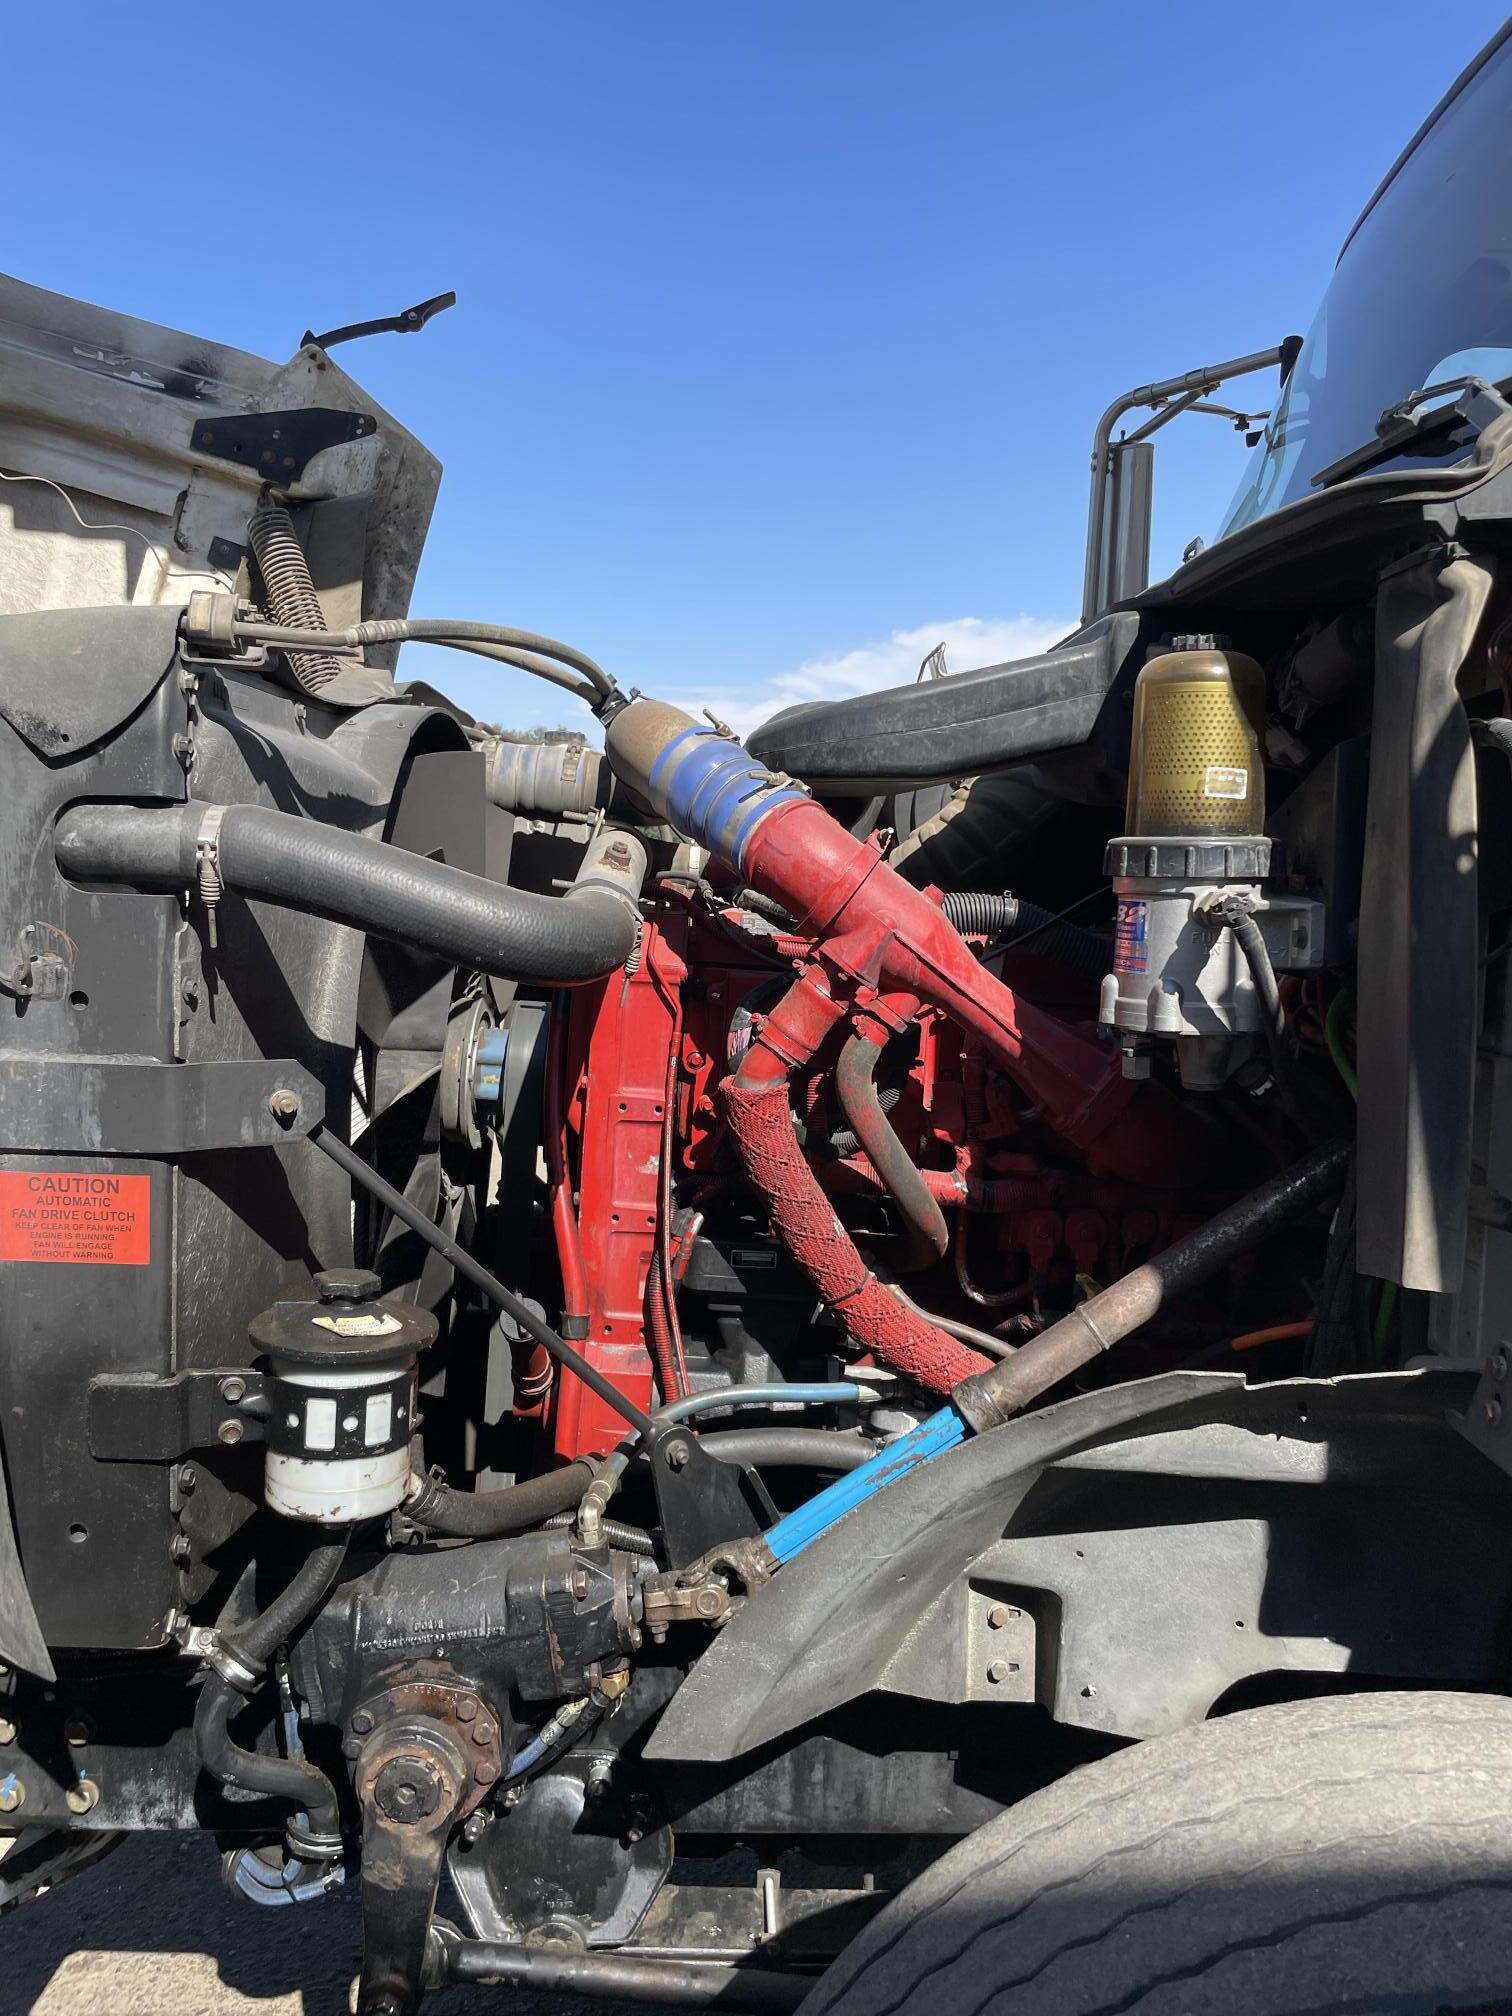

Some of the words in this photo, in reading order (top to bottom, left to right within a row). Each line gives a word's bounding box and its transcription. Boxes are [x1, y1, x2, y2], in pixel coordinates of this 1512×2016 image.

[28, 1176, 120, 1194] CAUTION
[36, 1195, 112, 1207] AUTOMATIC
[11, 1208, 37, 1218] FAN
[41, 1209, 80, 1220] DRIVE
[83, 1210, 135, 1222] CLUTCH
[15, 1221, 38, 1229] KEEP
[72, 1223, 84, 1231] OF
[86, 1224, 104, 1232] FAN
[105, 1225, 132, 1233] WHEN
[30, 1231, 63, 1240] ENGINE
[64, 1232, 73, 1240] IS
[33, 1240, 51, 1248] FAN
[53, 1241, 74, 1249] WILL
[76, 1242, 113, 1250] ENGAGE
[31, 1249, 71, 1258] WITHOUT
